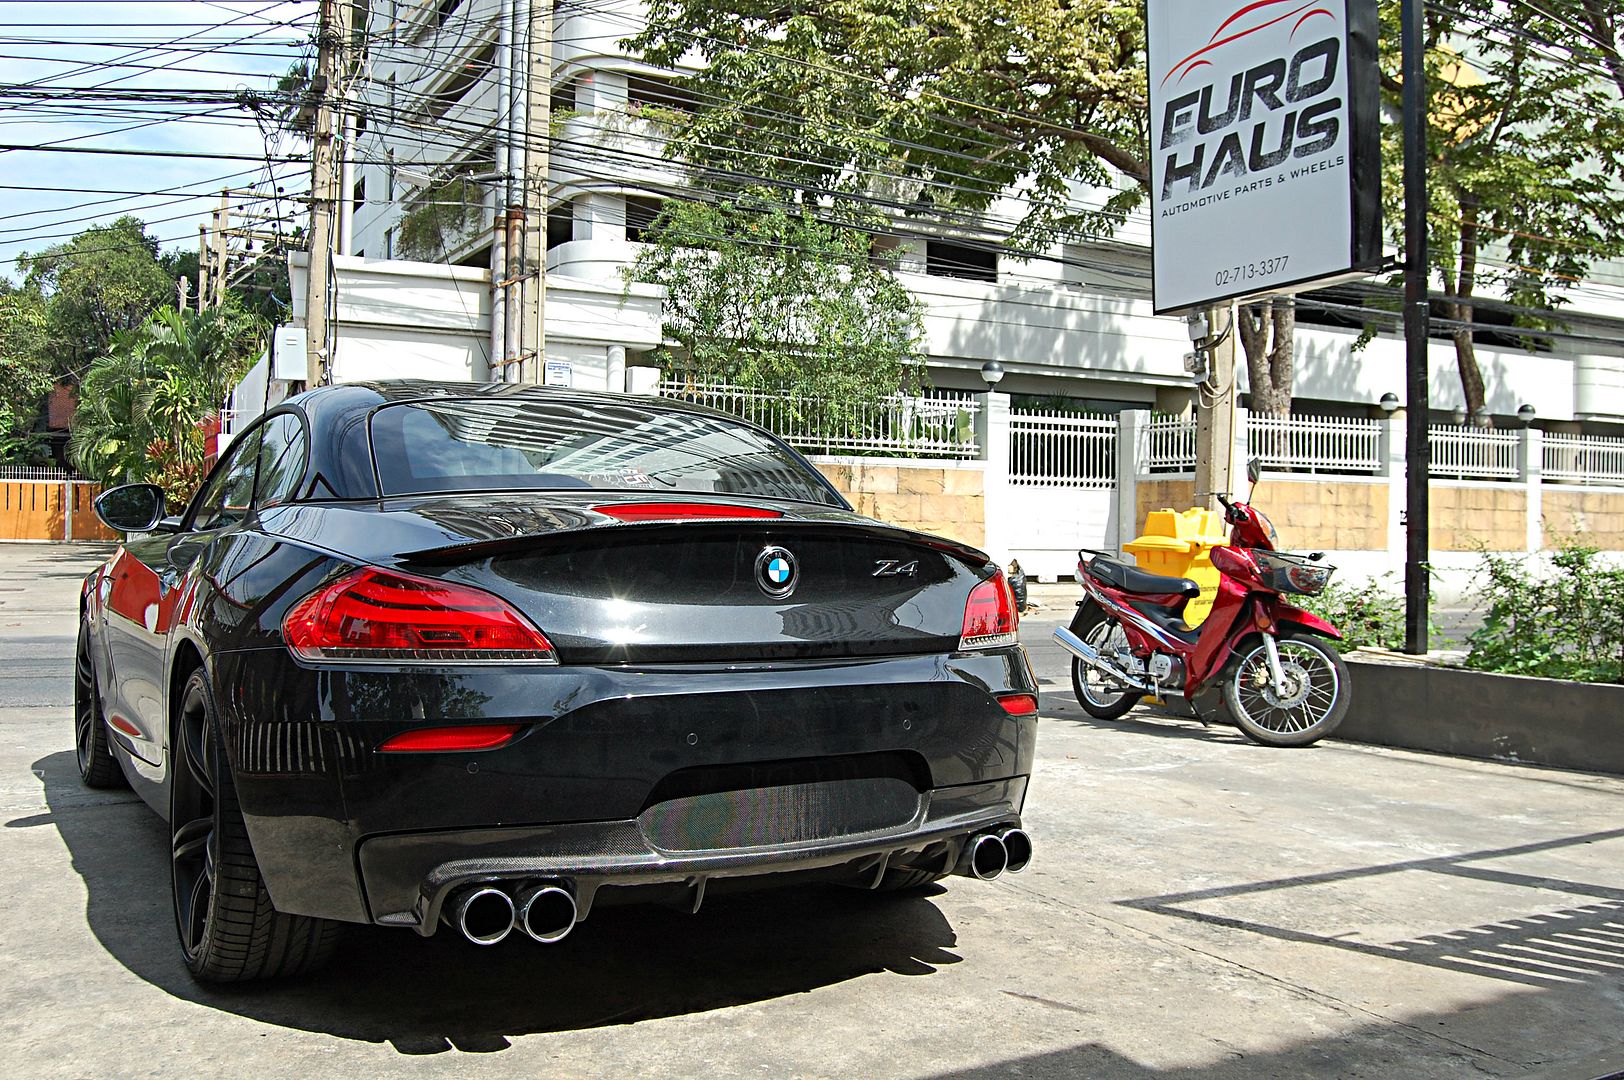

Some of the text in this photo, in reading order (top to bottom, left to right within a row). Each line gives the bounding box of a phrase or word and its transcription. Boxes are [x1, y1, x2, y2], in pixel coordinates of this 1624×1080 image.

[1160, 37, 1340, 150] EURO
[1161, 97, 1342, 201] HAUS
[1162, 155, 1344, 217] AUTOMOTIVE PARTS & WHEELS
[1215, 256, 1289, 286] 02-713-3377
[872, 559, 919, 577] Z4
